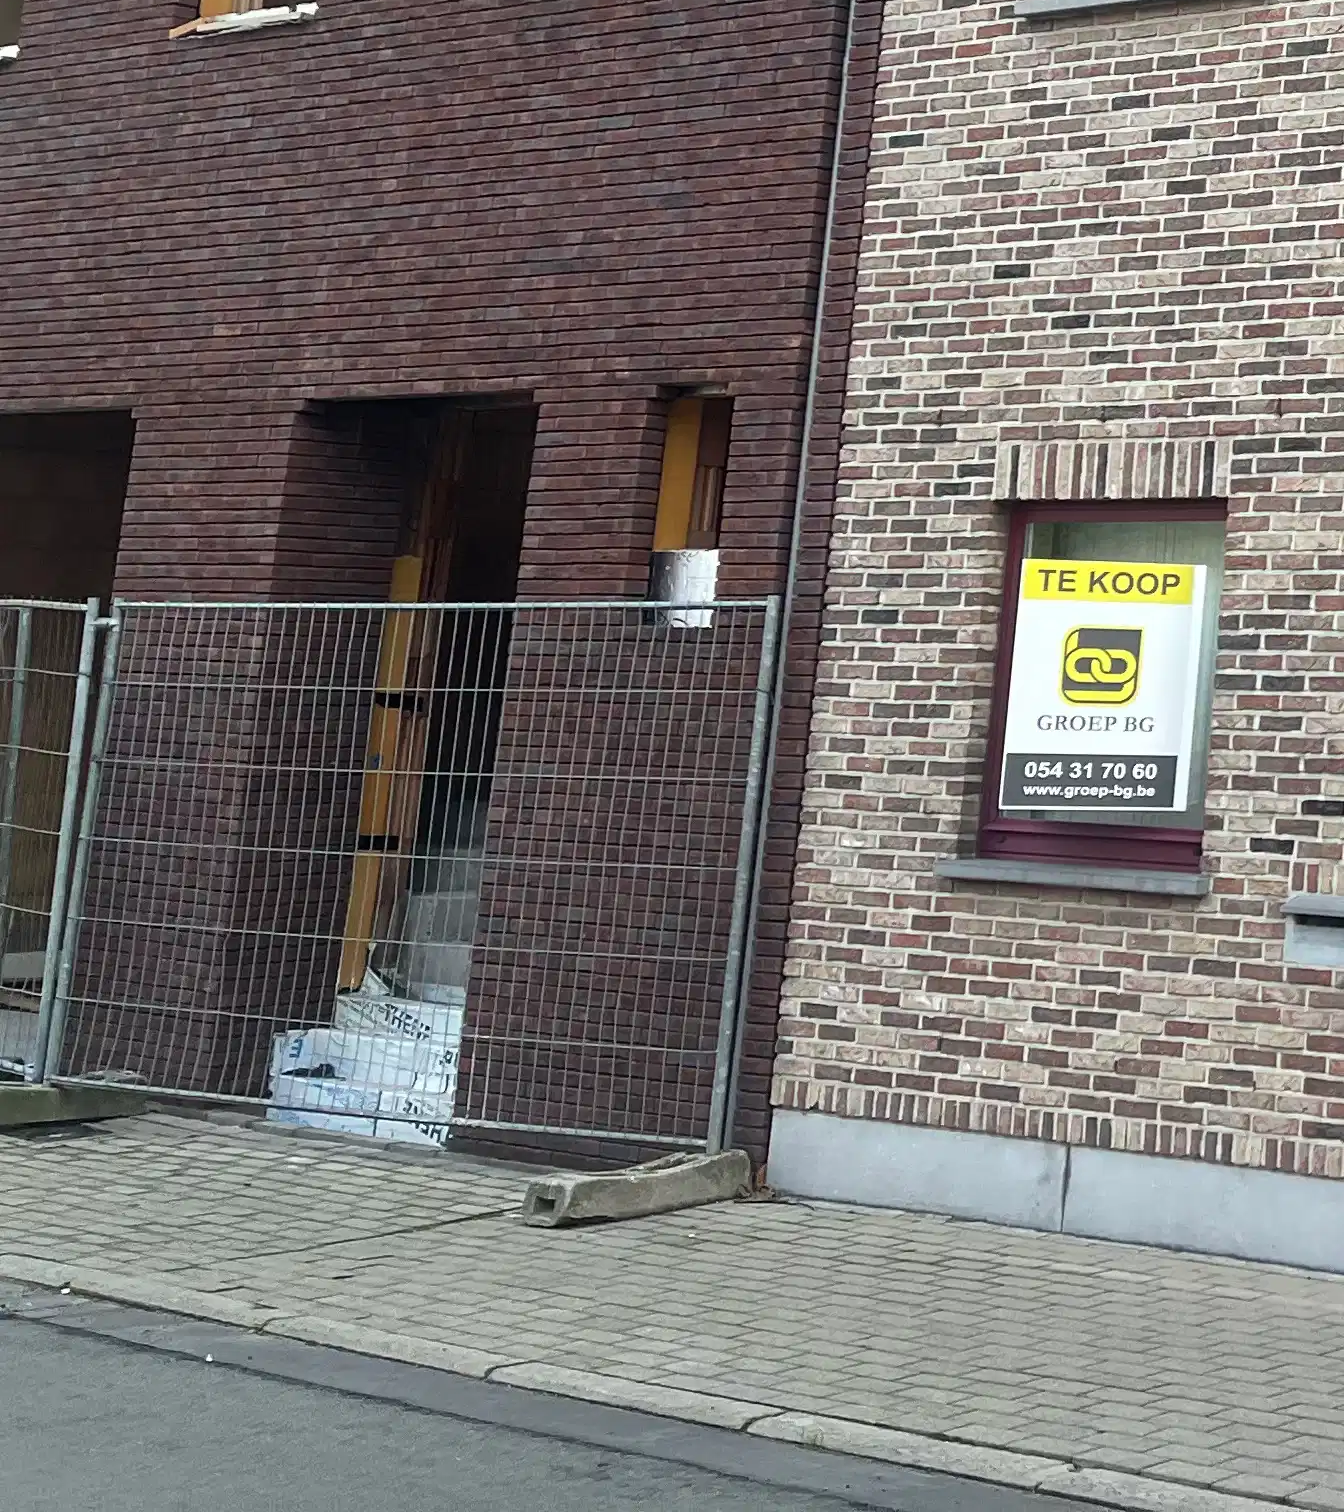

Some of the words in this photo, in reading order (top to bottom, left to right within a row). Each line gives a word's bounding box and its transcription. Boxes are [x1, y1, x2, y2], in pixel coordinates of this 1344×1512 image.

[1037, 569, 1077, 592] TE
[1088, 571, 1181, 596] KOOP
[1036, 714, 1117, 732] GROEP
[1123, 716, 1155, 733] BG
[1024, 761, 1063, 778] 054
[1068, 761, 1093, 779] 31
[1101, 762, 1127, 779] 70
[1132, 763, 1158, 780] 60
[1022, 784, 1156, 799] www.groep-bg.be
